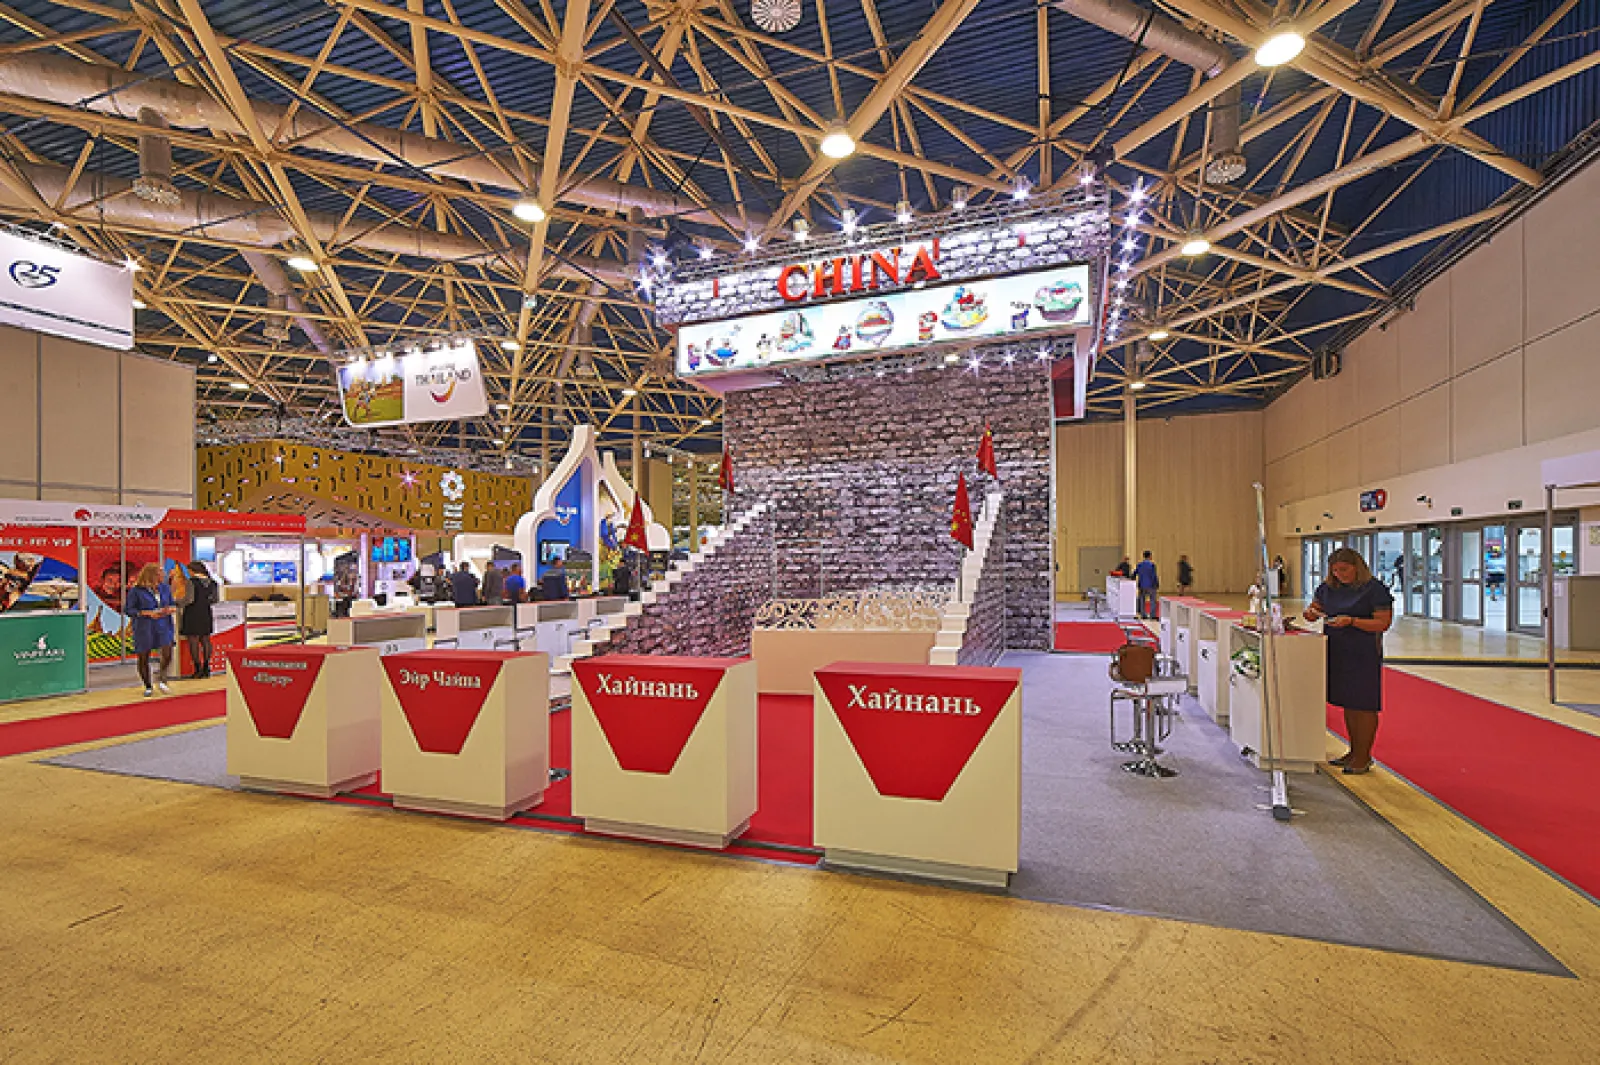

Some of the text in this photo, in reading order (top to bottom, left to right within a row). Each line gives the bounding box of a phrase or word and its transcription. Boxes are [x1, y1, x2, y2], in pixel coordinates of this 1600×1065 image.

[777, 245, 942, 301] CHINA
[400, 668, 430, 690] Эйр
[596, 673, 699, 700] Хайнань
[847, 684, 982, 716] Хайнань
